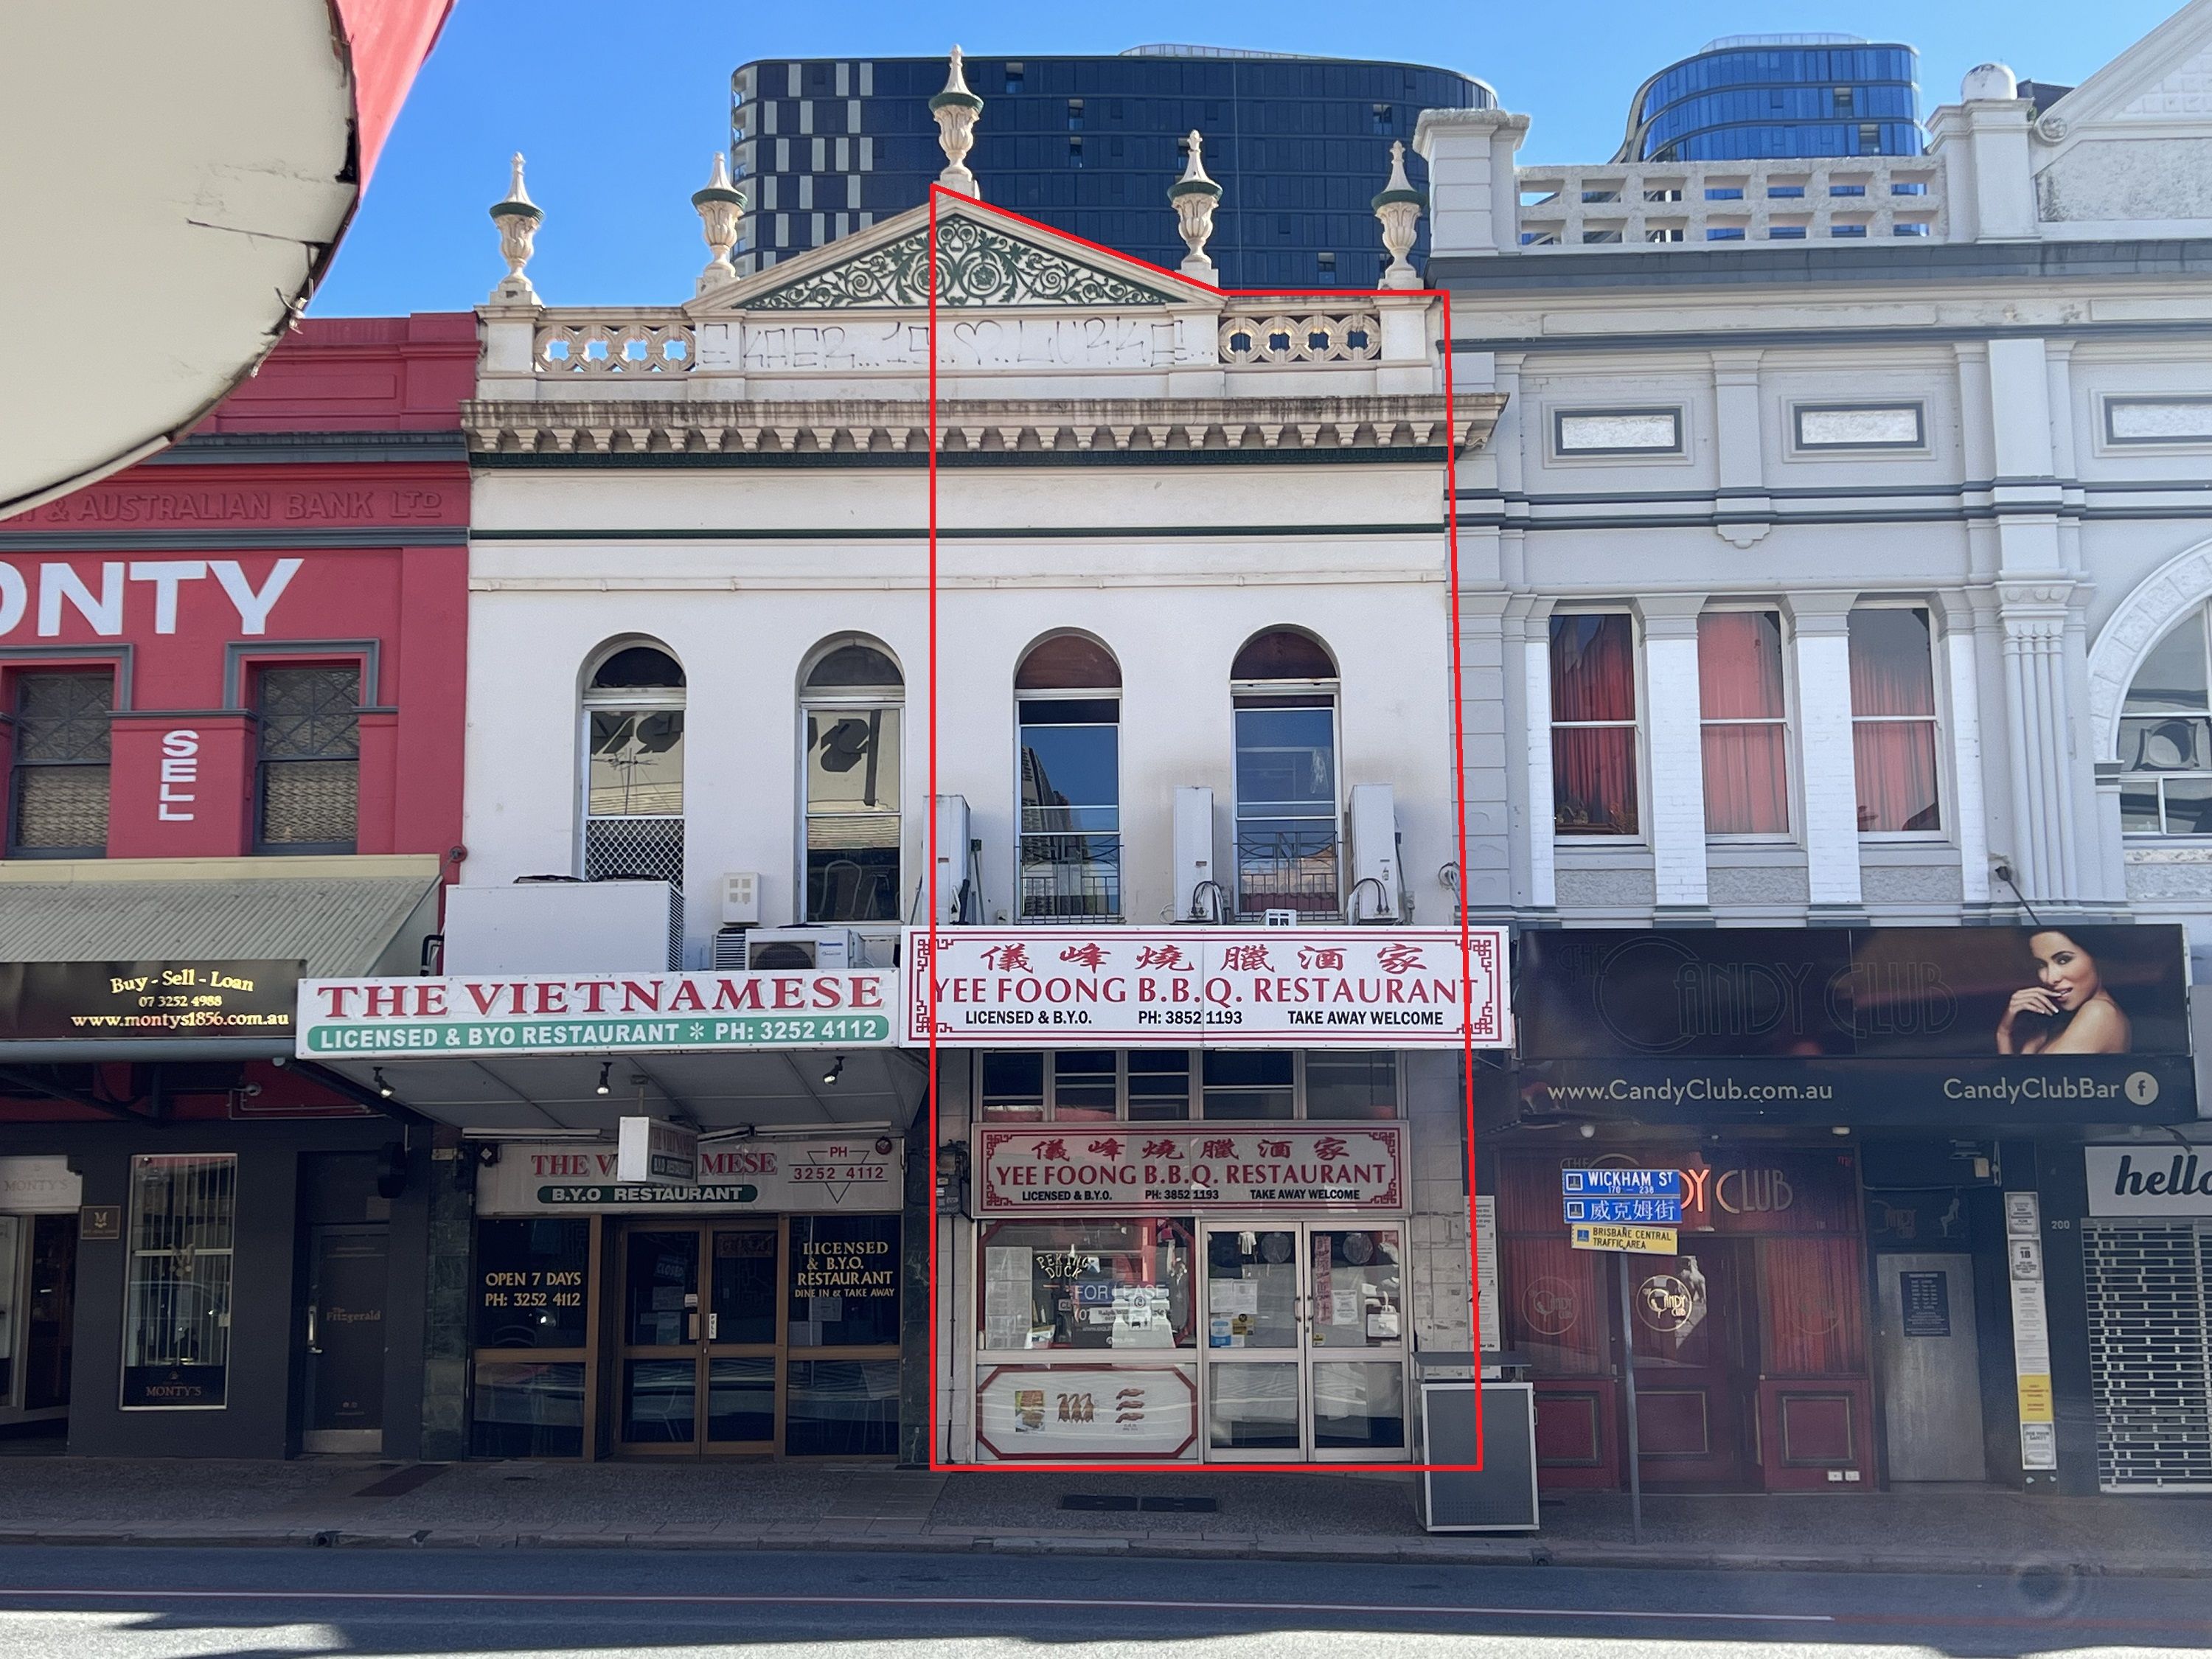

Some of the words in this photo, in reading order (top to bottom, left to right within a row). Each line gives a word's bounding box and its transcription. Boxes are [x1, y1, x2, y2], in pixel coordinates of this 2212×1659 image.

[77, 489, 270, 521] AUSTRALIAN
[281, 491, 372, 518] BANK
[391, 490, 442, 518] LTD
[159, 730, 198, 821] SELL
[111, 976, 149, 994] Buy
[162, 968, 195, 987] Sell
[210, 971, 254, 992] Loan
[317, 985, 448, 1018] THE
[465, 976, 883, 1016] VIETNAMESE
[936, 978, 986, 1003] YEE
[998, 978, 1126, 1003] FOONG
[1138, 978, 1242, 1008] B.B.Q.
[1255, 978, 1478, 1004] RESTAURANT
[1825, 961, 1958, 1039] CLUB
[139, 996, 155, 1007] 07
[158, 996, 188, 1006] 3252
[191, 995, 223, 1007] 4988
[72, 1011, 289, 1029] www.montys1856.com.au
[966, 1010, 1033, 1024] LICENSED
[1037, 1010, 1049, 1024] &
[1053, 1010, 1092, 1024] B.Y.O.
[1138, 1010, 1161, 1024] PH:
[1166, 1010, 1202, 1024] 3852
[1206, 1010, 1242, 1025] 1193
[1288, 1010, 1324, 1024] TAKE
[1327, 1010, 1367, 1025] AWAY
[1371, 1010, 1443, 1025] WELCOME
[320, 1029, 438, 1049] LICENSED
[445, 1027, 461, 1047] &
[468, 1026, 515, 1046] BYO
[522, 1022, 680, 1044] RESTAURANT
[715, 1021, 754, 1040] PH:
[760, 1020, 815, 1040] 3252
[821, 1019, 877, 1038] 4112
[1549, 1079, 1833, 1105] www.CandyClub.com.au
[1944, 1077, 2120, 1105] CandyClubBar
[830, 1147, 847, 1158] PH
[531, 1154, 590, 1177] THE
[794, 1167, 835, 1180] 3252
[846, 1166, 883, 1179] 4112
[996, 1166, 1037, 1185] YEE
[1044, 1166, 1136, 1185] FOONG
[1144, 1165, 1218, 1187] B.B.Q.
[1226, 1164, 1386, 1184] RESTAURANT
[1587, 1171, 1651, 1186] WICKHAM
[2114, 1155, 2212, 1196] hello
[552, 1188, 602, 1201] B.Y.O
[614, 1186, 742, 1201] RESTAURANT
[1022, 1191, 1071, 1202] LICENSED
[1074, 1191, 1082, 1202] &
[1085, 1191, 1113, 1202] B.Y.O.
[1144, 1190, 1162, 1201] PH:
[1164, 1190, 1190, 1201] 3852
[1193, 1189, 1219, 1200] 1193
[1251, 1189, 1276, 1200] TAKE
[1278, 1189, 1305, 1200] AWAY
[1308, 1189, 1360, 1200] WELCOME
[1716, 1169, 1794, 1213] CLUB
[1590, 1199, 1677, 1220] 威克姆街
[2051, 1220, 2070, 1230] 200
[1593, 1227, 1632, 1238] BRISBANE
[1635, 1230, 1672, 1241] CENTRAL
[803, 1242, 888, 1255] LICENSED
[1593, 1237, 1624, 1248] TRAFFIC
[1627, 1239, 1646, 1250] AREA
[807, 1257, 818, 1270] &
[827, 1256, 864, 1270] B.Y.O.
[485, 1273, 526, 1286] OPEN
[532, 1273, 540, 1285] 7
[546, 1272, 581, 1285] DAYS
[798, 1272, 893, 1286] RESTAURANT
[1045, 1265, 1082, 1279] DUCK
[485, 1293, 507, 1307] PH:
[513, 1293, 547, 1307] 3252
[552, 1293, 581, 1306] 4112
[795, 1290, 815, 1298] DINE
[818, 1290, 830, 1298] IN
[871, 1288, 895, 1297] AWAY
[1075, 1285, 1107, 1301] FOR
[326, 1308, 381, 1324] Fitzgerald
[145, 1386, 201, 1397] MONTY'S
